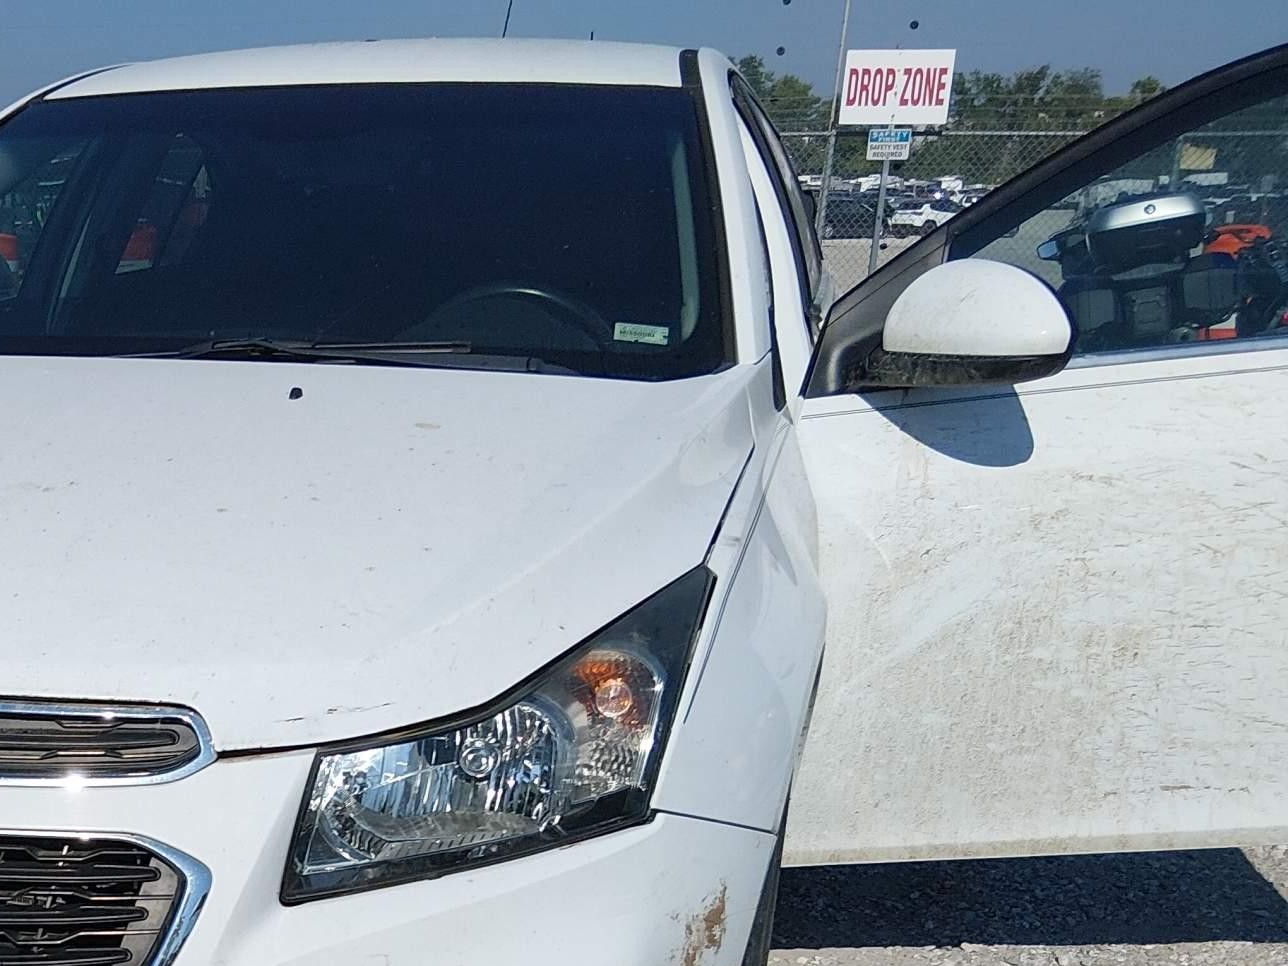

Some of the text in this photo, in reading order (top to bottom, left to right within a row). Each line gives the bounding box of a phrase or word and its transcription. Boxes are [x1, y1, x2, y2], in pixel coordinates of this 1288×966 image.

[845, 67, 948, 107] DROP ZONE
[871, 131, 908, 139] SAFETY
[870, 143, 907, 151] SAFETY VEST
